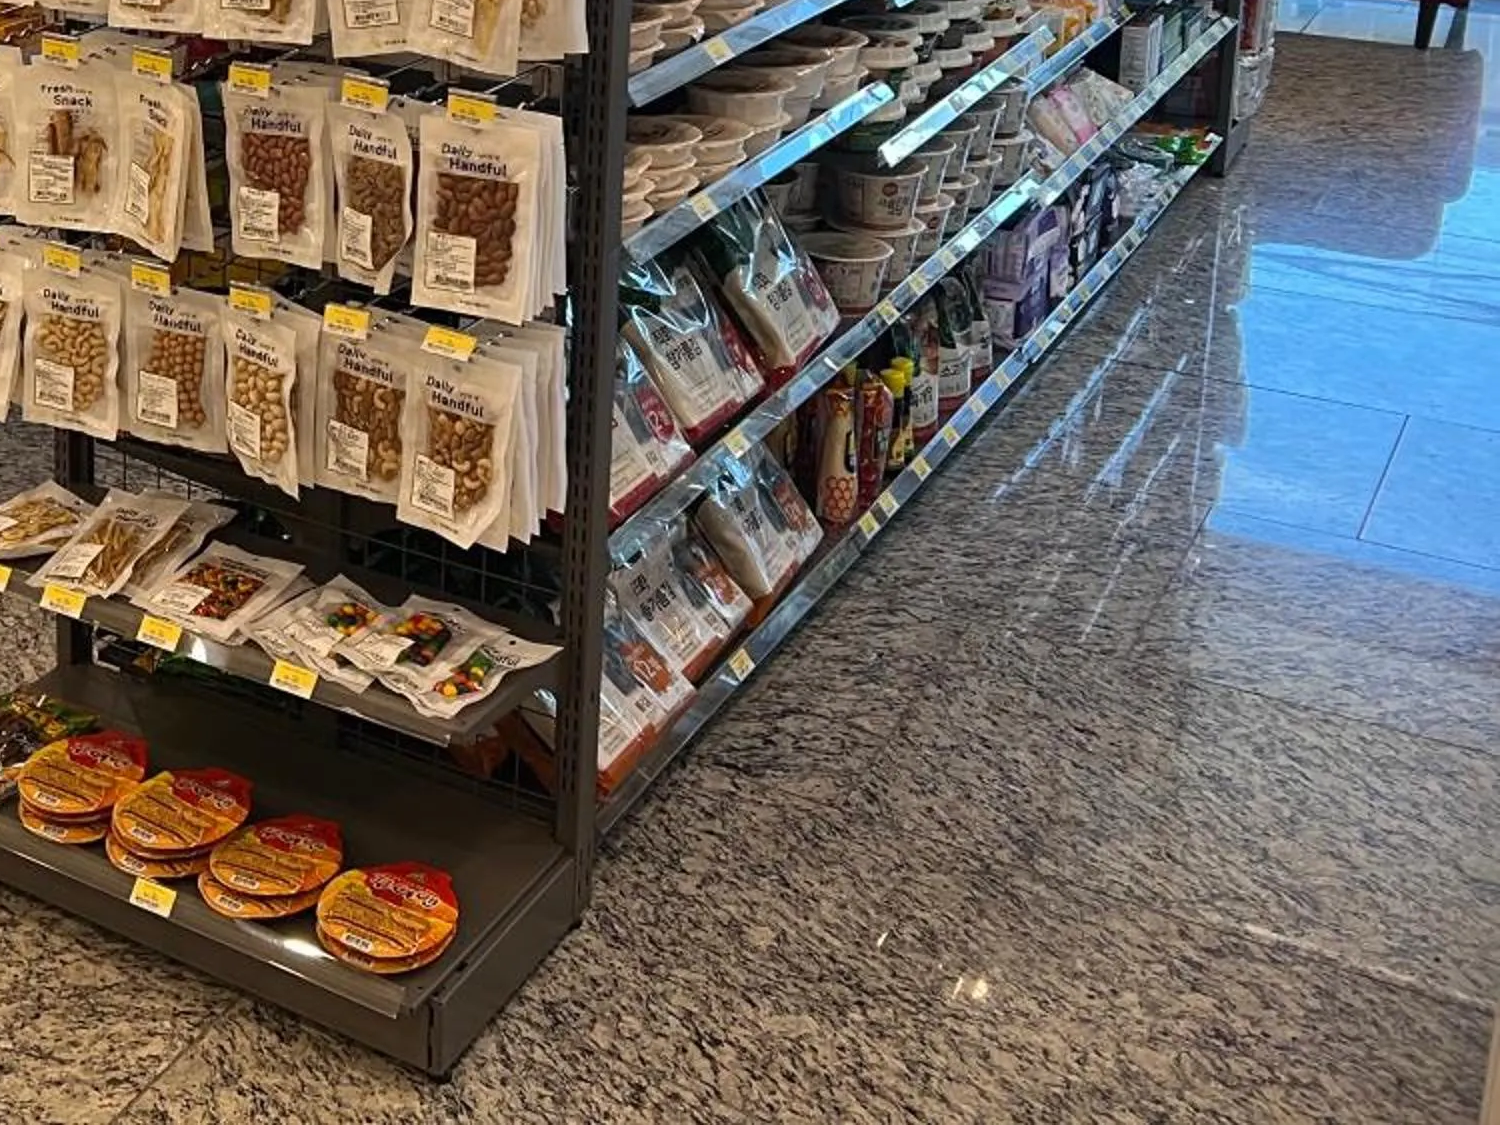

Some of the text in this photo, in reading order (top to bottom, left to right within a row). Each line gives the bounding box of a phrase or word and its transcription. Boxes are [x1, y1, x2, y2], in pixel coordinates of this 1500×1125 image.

[41, 83, 73, 95] Fresh
[53, 94, 93, 107] Snack
[243, 106, 272, 120] Daily
[251, 117, 301, 134] Handful
[441, 143, 474, 159] Daily
[449, 158, 508, 177] Handful
[43, 288, 70, 305] Daily
[51, 301, 101, 319] Handful
[426, 375, 455, 395] Daily
[431, 391, 484, 418] Handful
